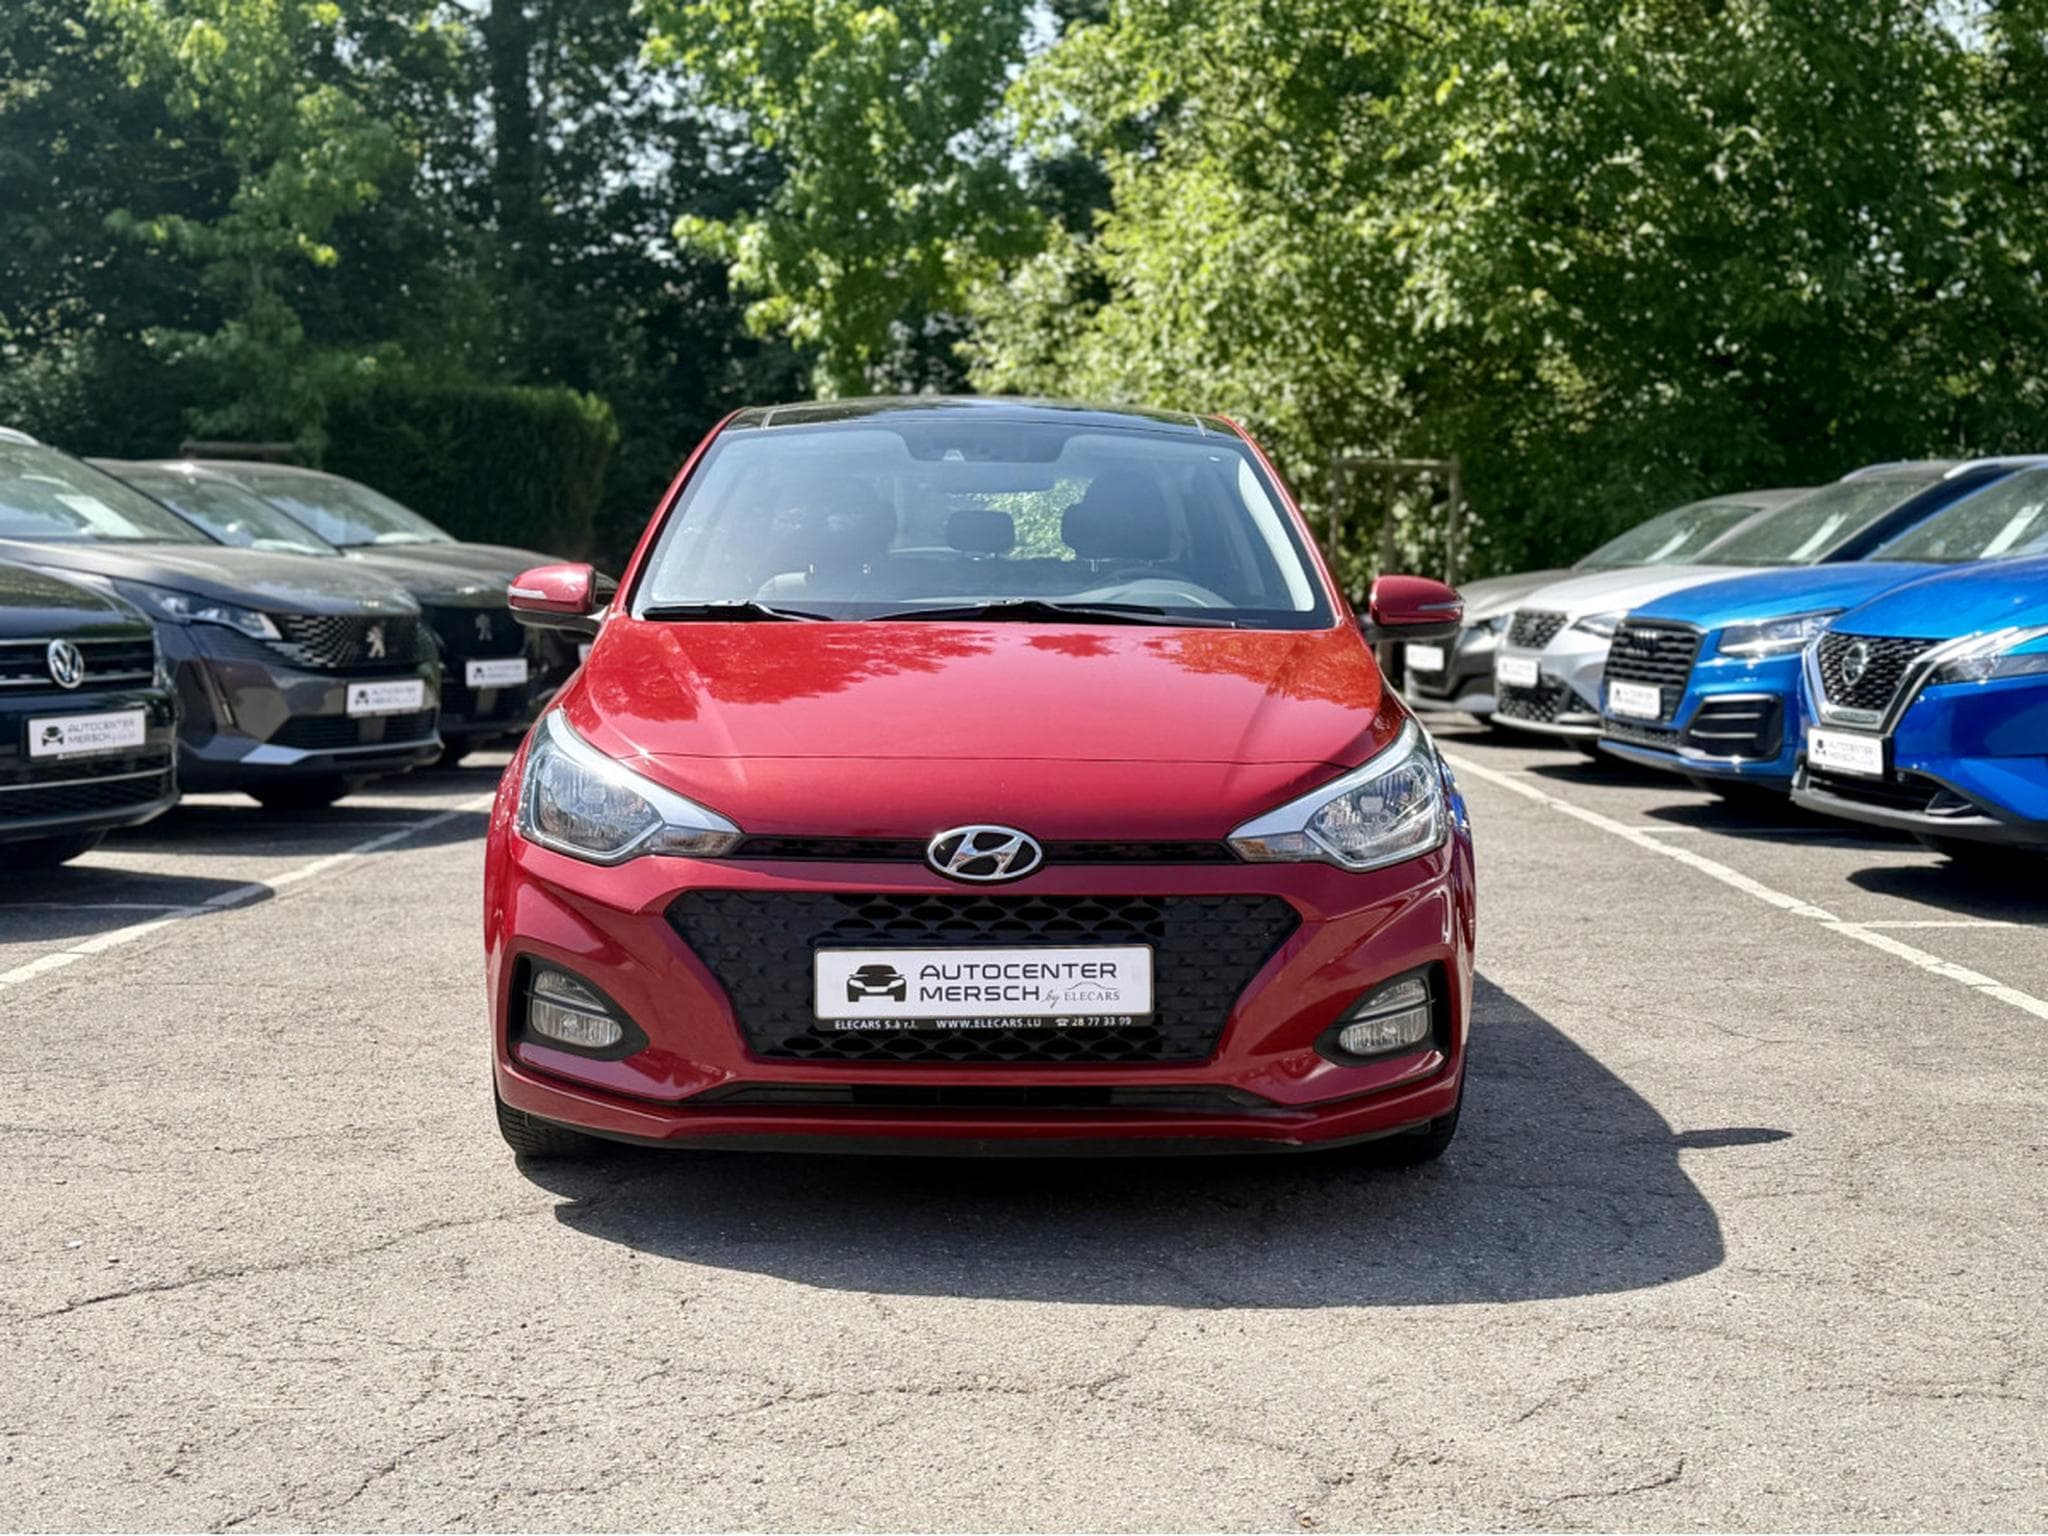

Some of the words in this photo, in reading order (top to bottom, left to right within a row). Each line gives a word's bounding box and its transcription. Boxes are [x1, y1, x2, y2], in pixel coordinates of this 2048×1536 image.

[919, 962, 1118, 980] AUTOCENTER
[919, 985, 1040, 1001] MERSCH
[1041, 989, 1061, 1009] by
[1064, 991, 1120, 1001] ELECARS
[834, 1020, 881, 1030] ELECARS
[936, 1018, 1042, 1029] WWW.ELECARS.LU
